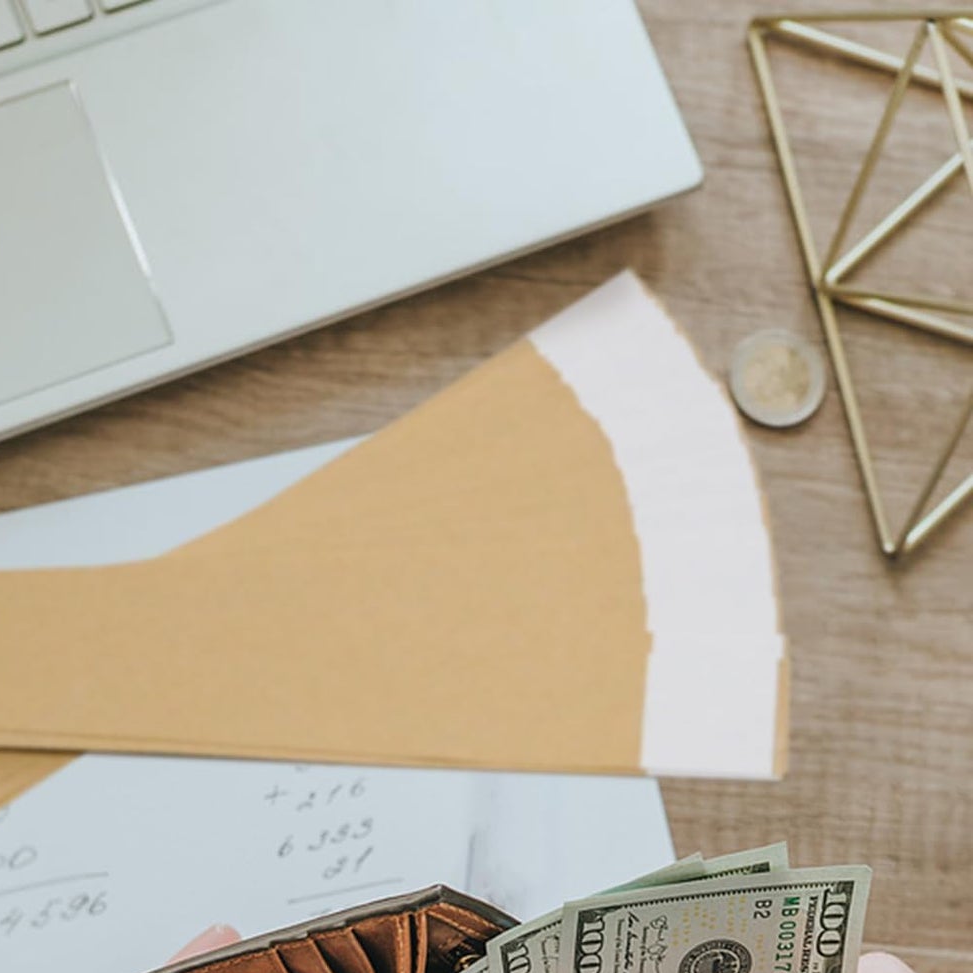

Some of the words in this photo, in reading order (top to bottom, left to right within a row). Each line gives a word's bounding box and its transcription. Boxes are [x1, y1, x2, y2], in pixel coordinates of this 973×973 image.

[753, 899, 773, 920] B2
[781, 896, 801, 917] MB
[801, 895, 819, 950] FEDERAL
[816, 887, 848, 958] 100
